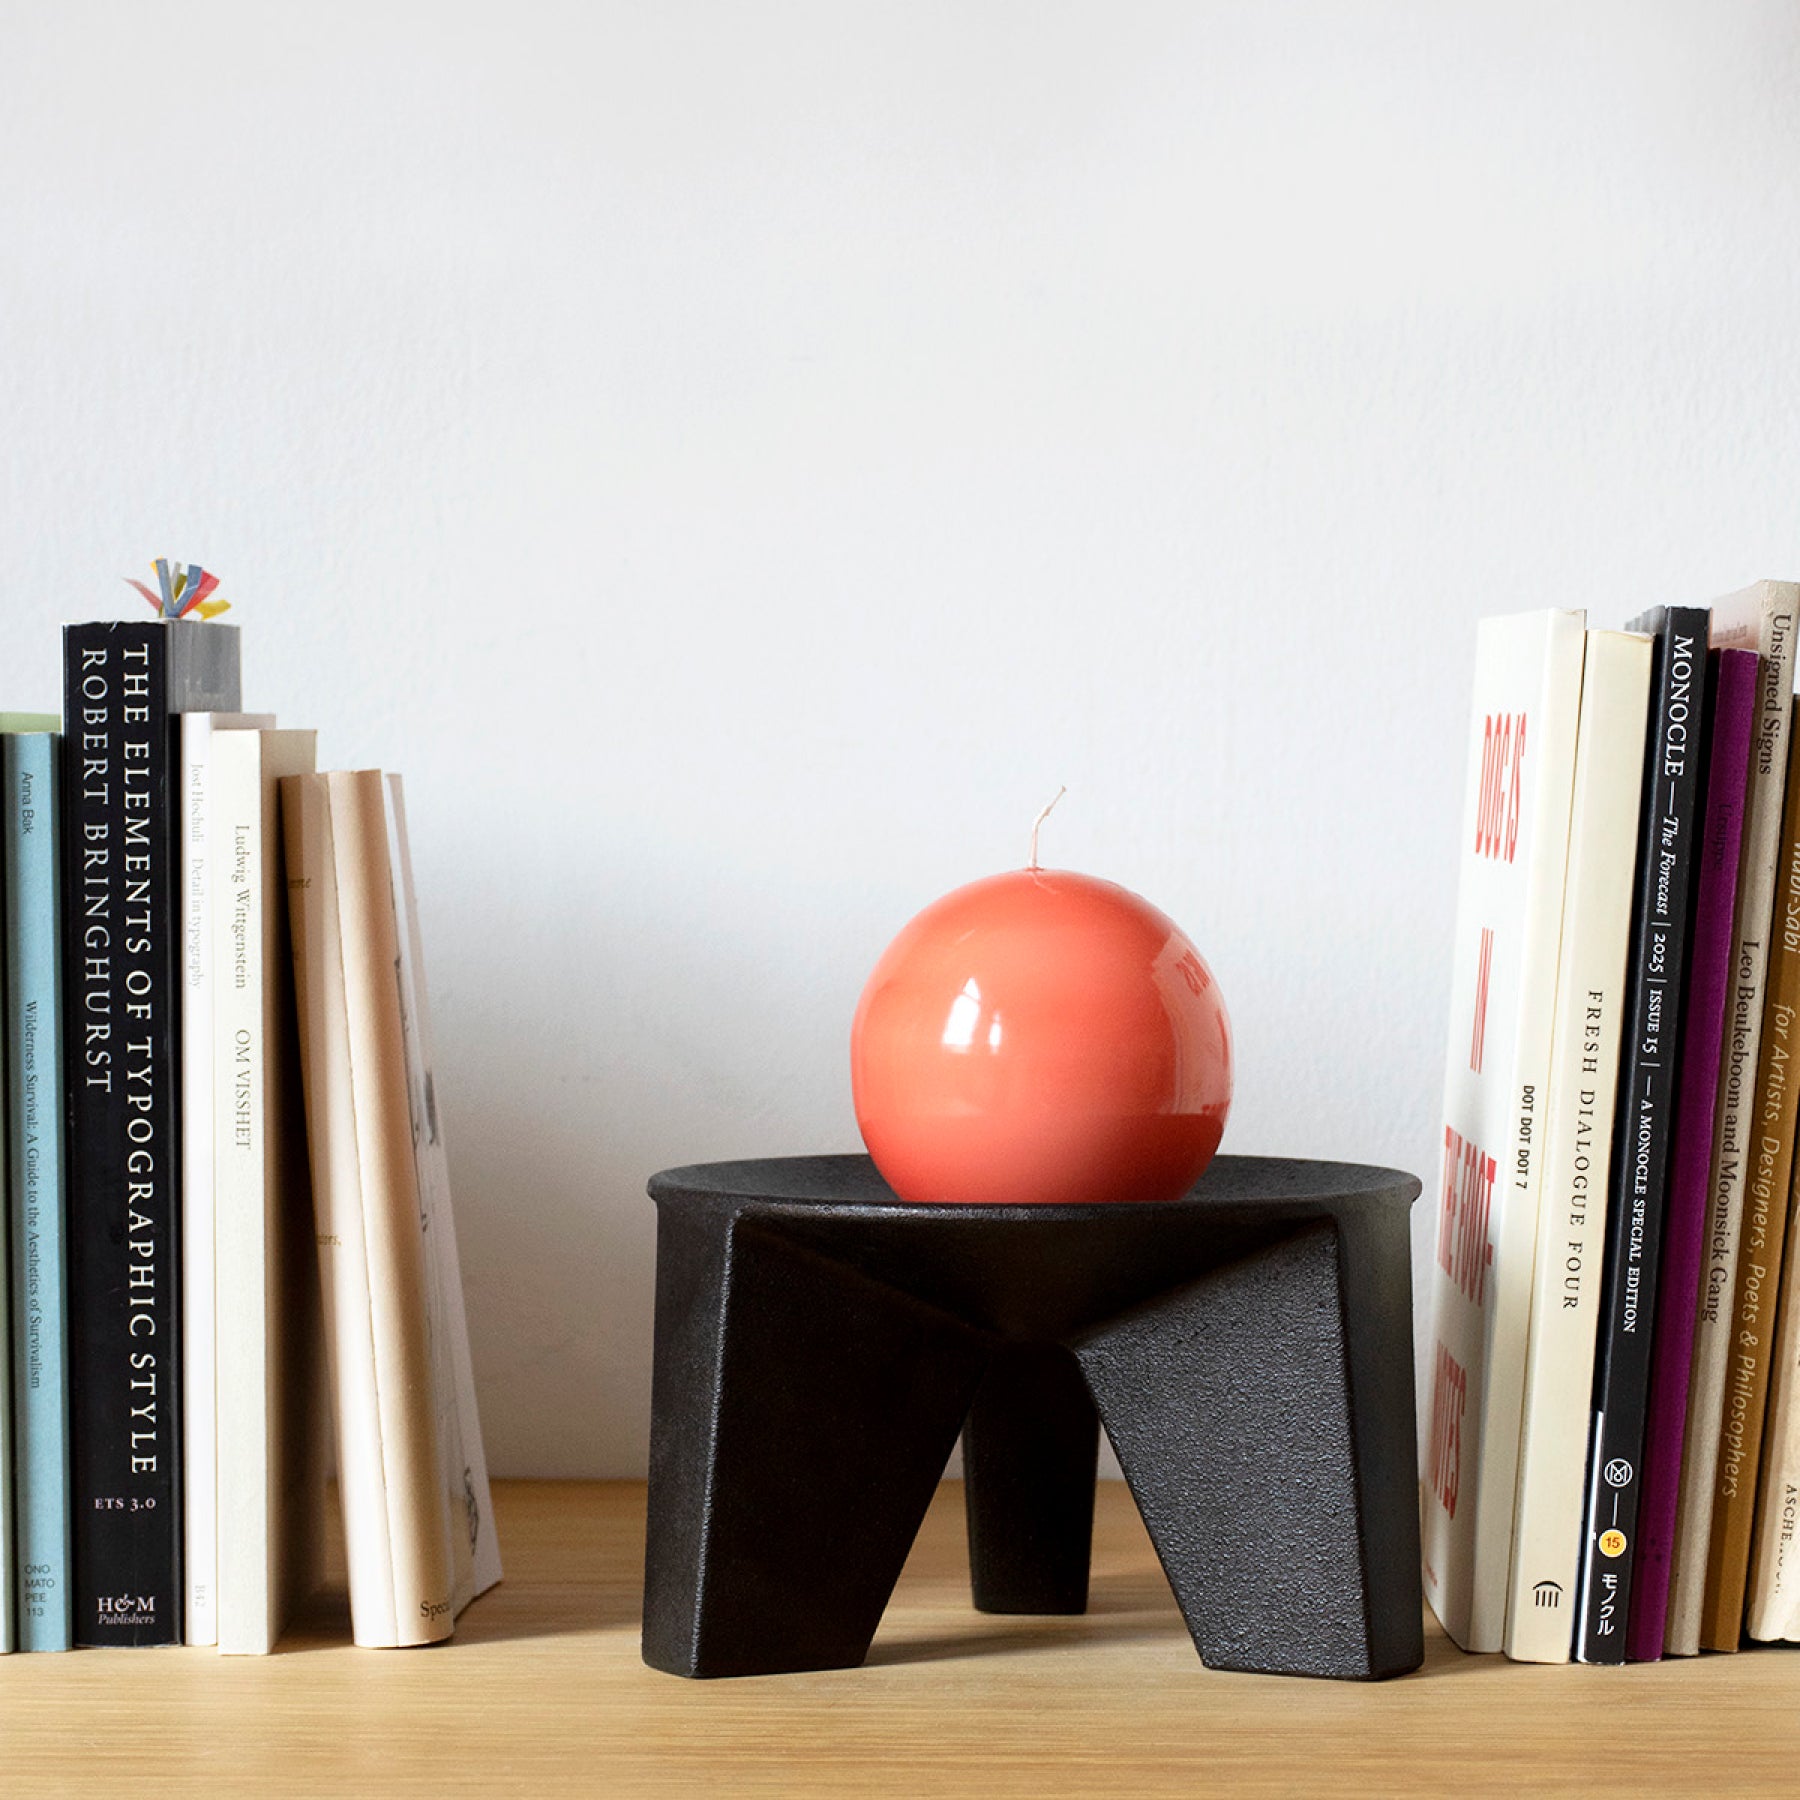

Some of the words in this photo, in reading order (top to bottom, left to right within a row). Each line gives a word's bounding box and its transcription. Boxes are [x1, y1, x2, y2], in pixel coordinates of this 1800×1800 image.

[124, 643, 150, 723] THE
[1763, 614, 1792, 710] Unsigned
[82, 648, 108, 804] ROBERT
[1664, 635, 1693, 777] MONOCLE
[1757, 718, 1779, 775] Signs
[22, 772, 34, 804] Anna
[190, 764, 204, 786] Jost
[22, 809, 34, 834] Bak
[192, 791, 204, 842] Hochuli
[1661, 816, 1679, 846] The
[124, 741, 153, 953] ELEMENTS
[231, 826, 250, 881] Ludwig
[192, 859, 204, 895] Detail
[1656, 851, 1676, 914] Forecast
[192, 900, 204, 912] in
[83, 823, 112, 1092] BRINGHURST
[188, 917, 204, 988] typography
[231, 889, 250, 989] Wittgenstein
[1646, 933, 1666, 972] 2025
[1739, 940, 1760, 978] Leo
[126, 970, 153, 1019] OF
[1646, 989, 1662, 1032] ISSUE
[25, 1001, 38, 1070] Wilderness
[235, 1029, 251, 1062] OM
[1582, 990, 1604, 1074] FRESH
[1642, 1037, 1659, 1053] 15
[1772, 1003, 1797, 1038] for
[1726, 986, 1756, 1108] Beukeboom
[26, 1074, 40, 1128] Survival:
[235, 1069, 251, 1151] VISSHET
[1521, 1085, 1535, 1112] DOT
[1641, 1099, 1653, 1109] A
[1762, 1044, 1790, 1126] Artists,
[27, 1133, 38, 1143] A
[1519, 1117, 1532, 1144] DOT
[1632, 1115, 1652, 1194] MONOCLE
[1722, 1116, 1741, 1152] and
[27, 1148, 40, 1187] Guide
[1517, 1149, 1530, 1176] DOT
[1569, 1089, 1596, 1226] DIALOGUE
[28, 1190, 39, 1203] to
[127, 1036, 156, 1337] TYPOGRAPHIC
[1515, 1181, 1528, 1189] 7
[1711, 1159, 1739, 1259] Moonsick
[1746, 1136, 1780, 1253] Designers,
[28, 1207, 40, 1227] the
[1628, 1199, 1645, 1261] SPECIAL
[29, 1231, 42, 1295] Aesthetics
[1562, 1241, 1583, 1309] FOUR
[30, 1299, 42, 1312] of
[1623, 1266, 1641, 1333] EDITION
[1702, 1267, 1728, 1323] Gang
[1740, 1263, 1768, 1322] Poets
[30, 1316, 43, 1389] Survivalism
[130, 1352, 157, 1473] STYLE
[1720, 1355, 1758, 1498] Philosophers
[95, 1497, 125, 1510] ETS
[131, 1497, 157, 1512] 3.0
[1606, 1533, 1620, 1548] 15
[24, 1564, 51, 1575] ONO
[24, 1578, 56, 1589] MATO
[25, 1593, 47, 1603] PEE
[26, 1607, 45, 1617] 113
[97, 1593, 156, 1613] H&M
[98, 1613, 156, 1626] Publishers
[1598, 1574, 1618, 1636] モノクル
